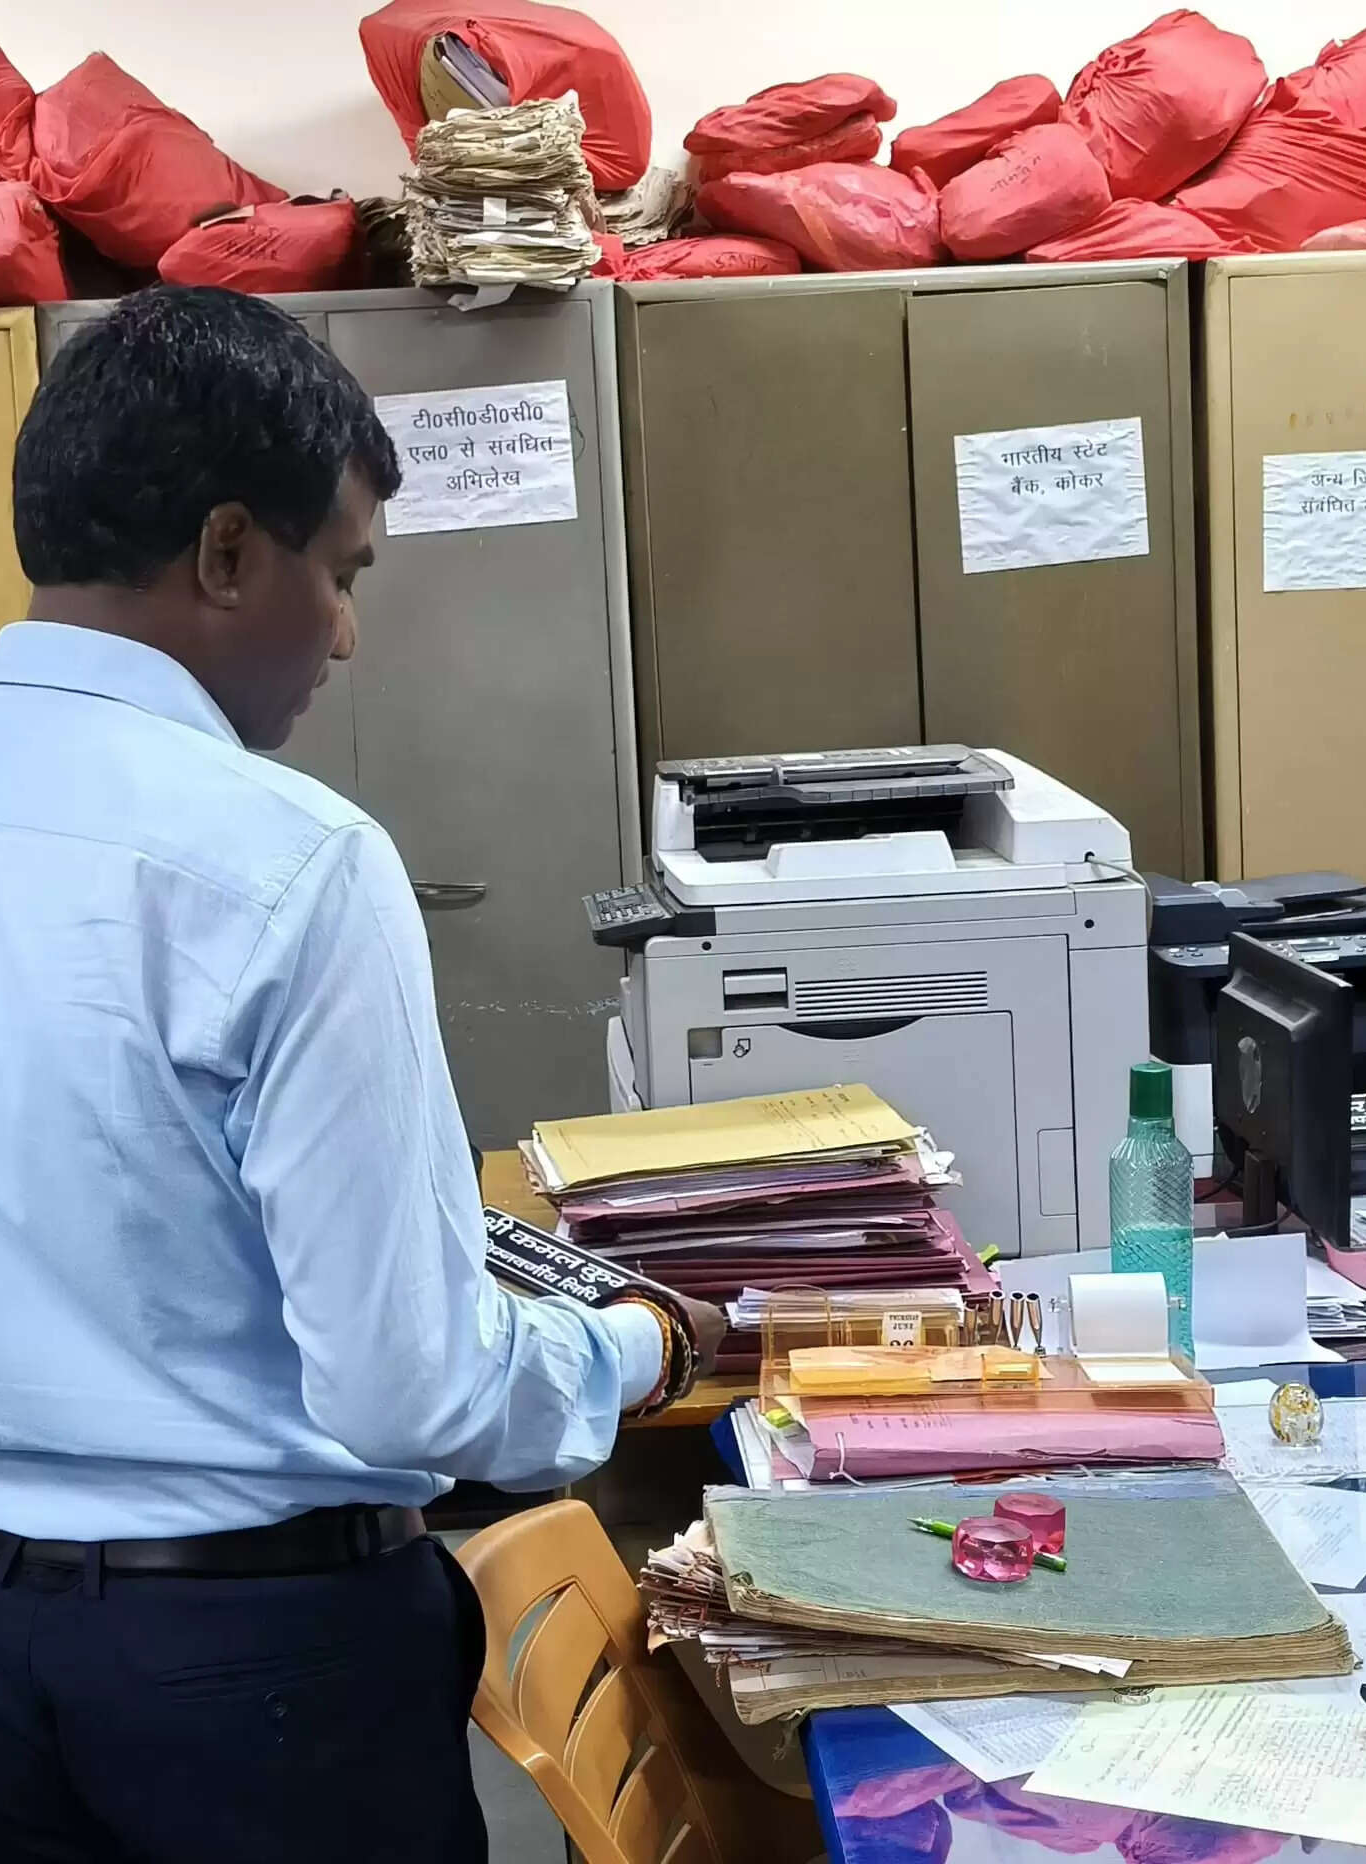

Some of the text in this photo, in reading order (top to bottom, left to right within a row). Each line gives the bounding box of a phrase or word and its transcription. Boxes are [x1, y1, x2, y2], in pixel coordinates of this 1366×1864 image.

[460, 437, 475, 459] से
[1001, 439, 1108, 467] भारतीय स्टेट
[446, 467, 521, 493] अभिलेख
[1053, 469, 1104, 492] कोकर
[1311, 472, 1343, 487] अन्य
[509, 1228, 584, 1270] कमल
